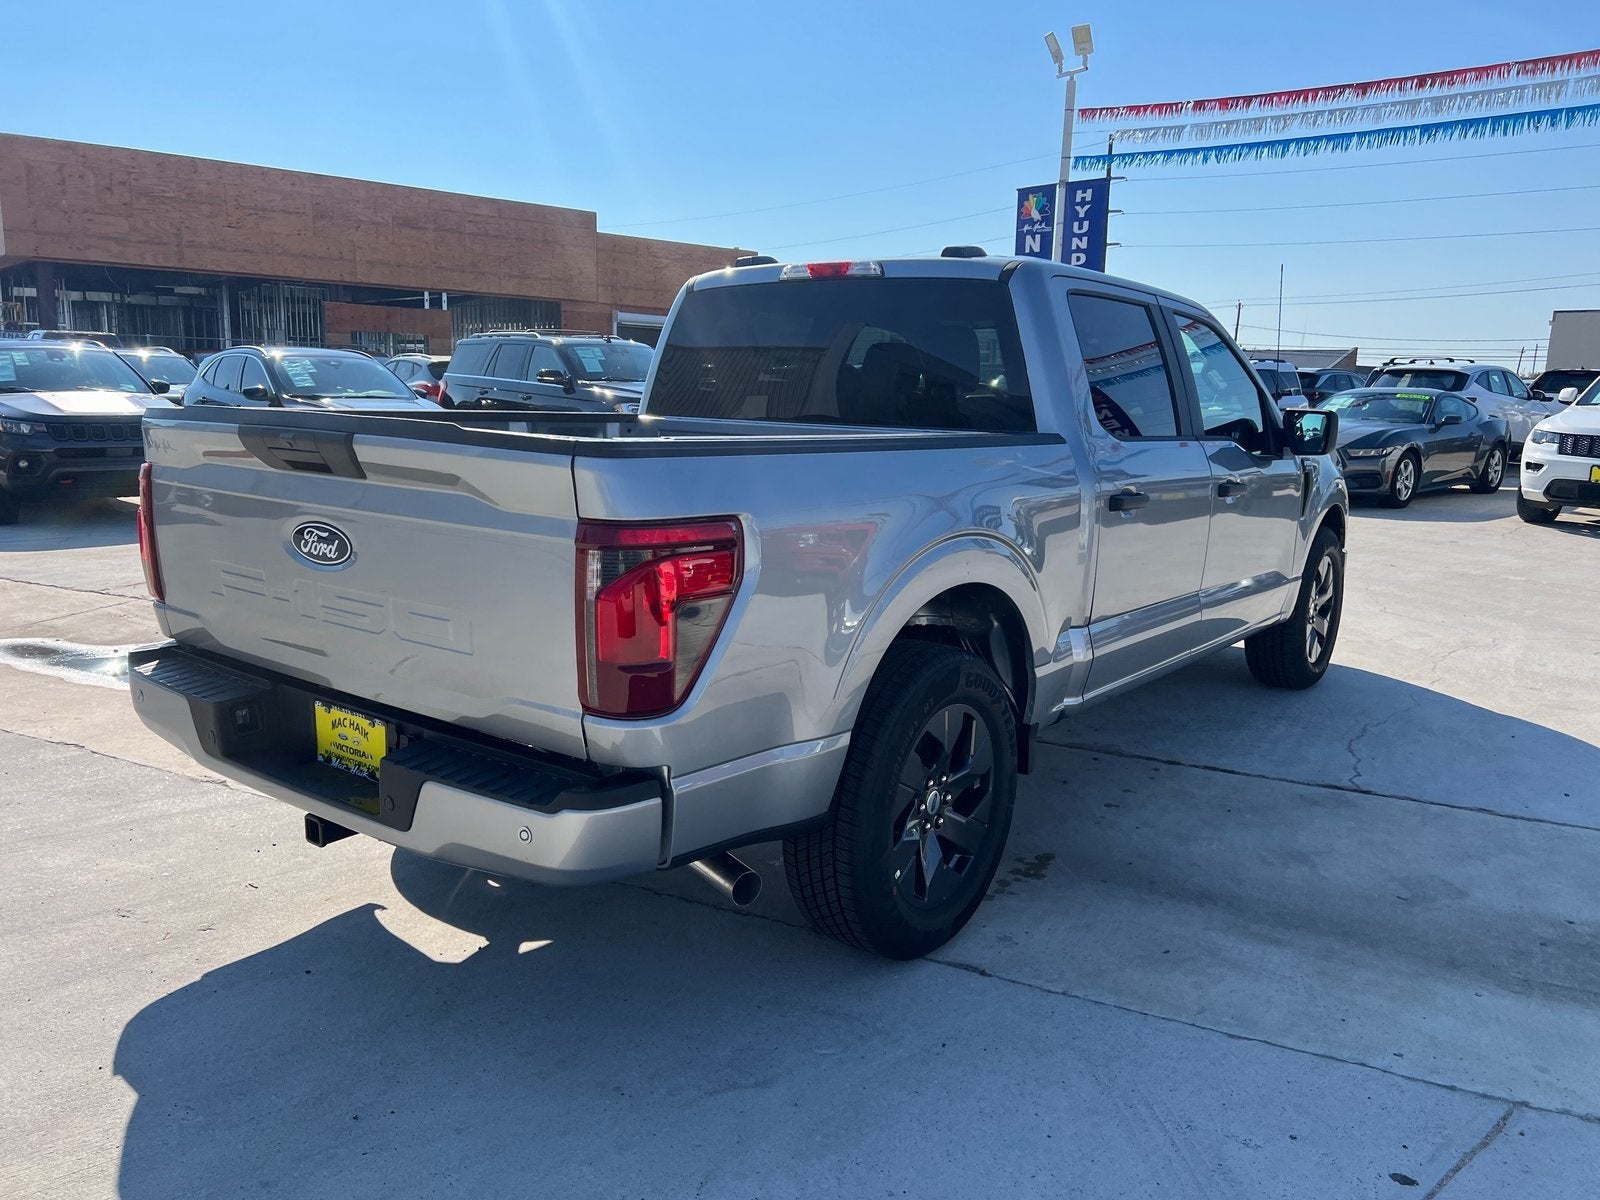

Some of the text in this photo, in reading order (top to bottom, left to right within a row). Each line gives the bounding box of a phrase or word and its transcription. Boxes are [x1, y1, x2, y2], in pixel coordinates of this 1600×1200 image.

[301, 527, 339, 559] Ford
[210, 559, 474, 657] F-150
[331, 717, 348, 731] MAC
[349, 718, 369, 742] HAIK
